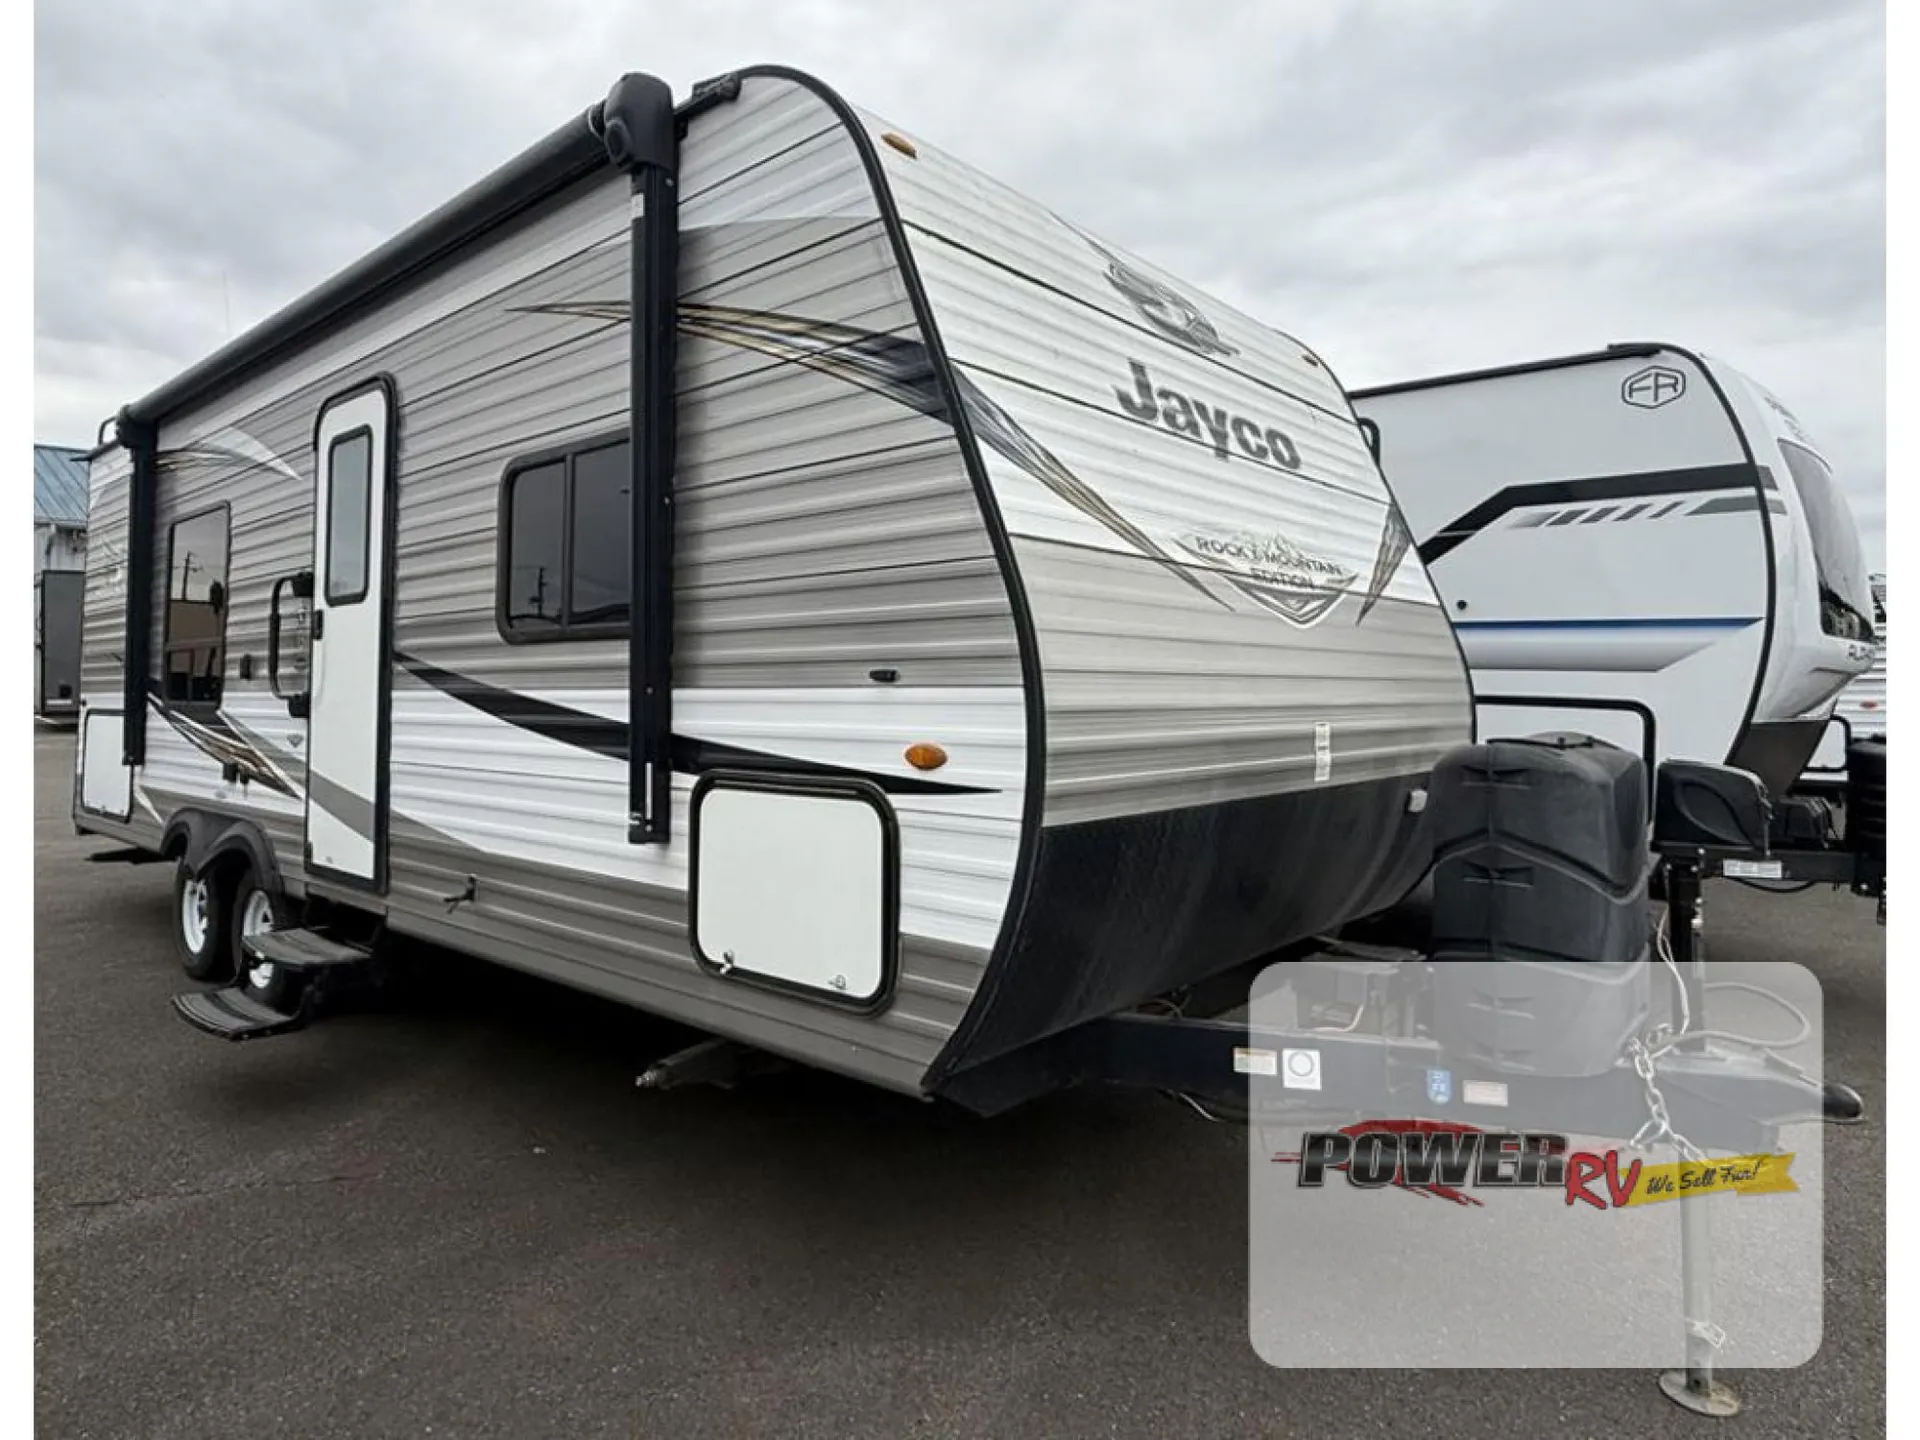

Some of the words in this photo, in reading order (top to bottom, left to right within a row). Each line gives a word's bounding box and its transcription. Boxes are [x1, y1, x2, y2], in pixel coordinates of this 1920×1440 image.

[1628, 372, 1679, 402] FR
[1112, 357, 1301, 469] Jayco
[1196, 535, 1259, 562] ROCKY
[1261, 548, 1343, 575] MOUNTAIN
